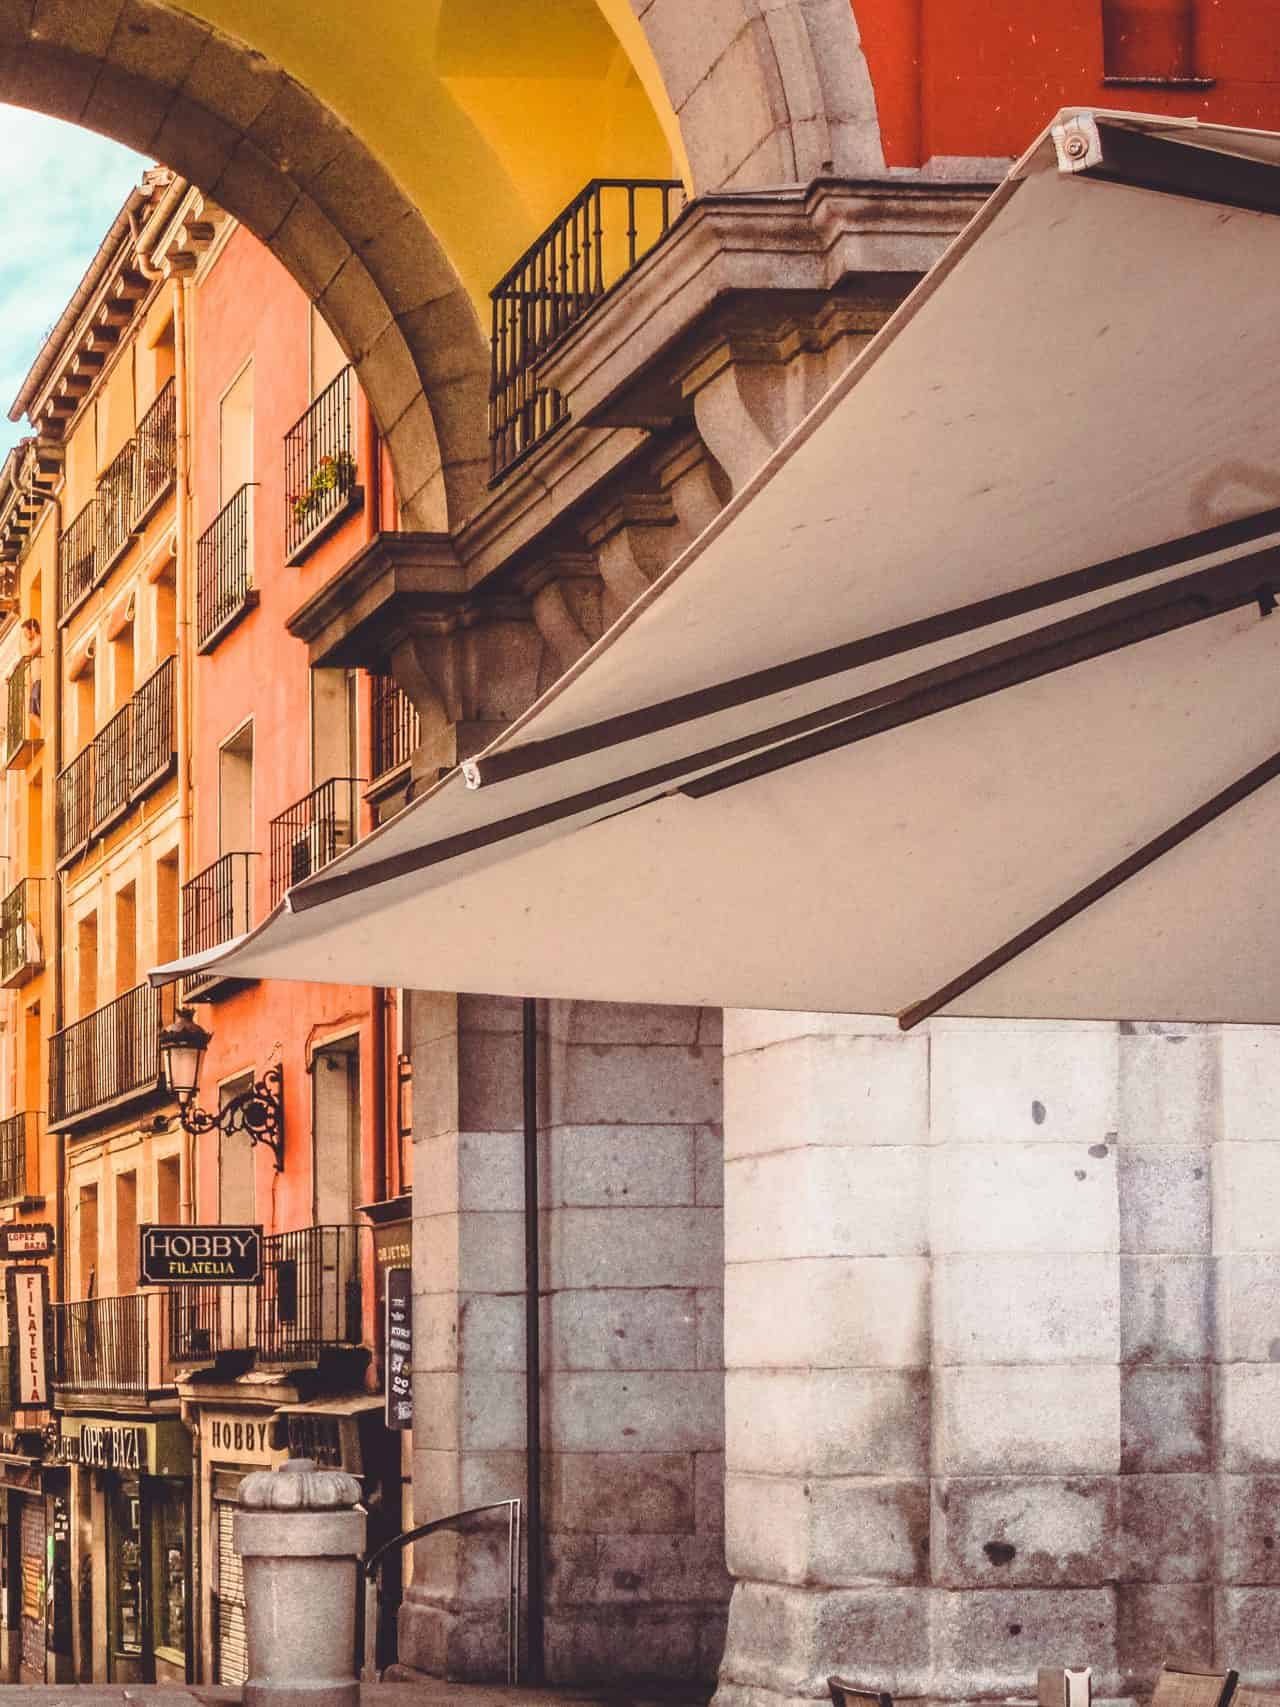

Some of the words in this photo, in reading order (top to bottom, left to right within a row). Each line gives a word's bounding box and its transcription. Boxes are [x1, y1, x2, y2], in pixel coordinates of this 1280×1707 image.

[149, 1235, 254, 1257] HOBBY
[168, 1261, 235, 1275] FILATELIA
[26, 1276, 40, 1401] FILATELIA
[111, 1426, 140, 1471] BAZA
[211, 1420, 267, 1453] HOBBY
